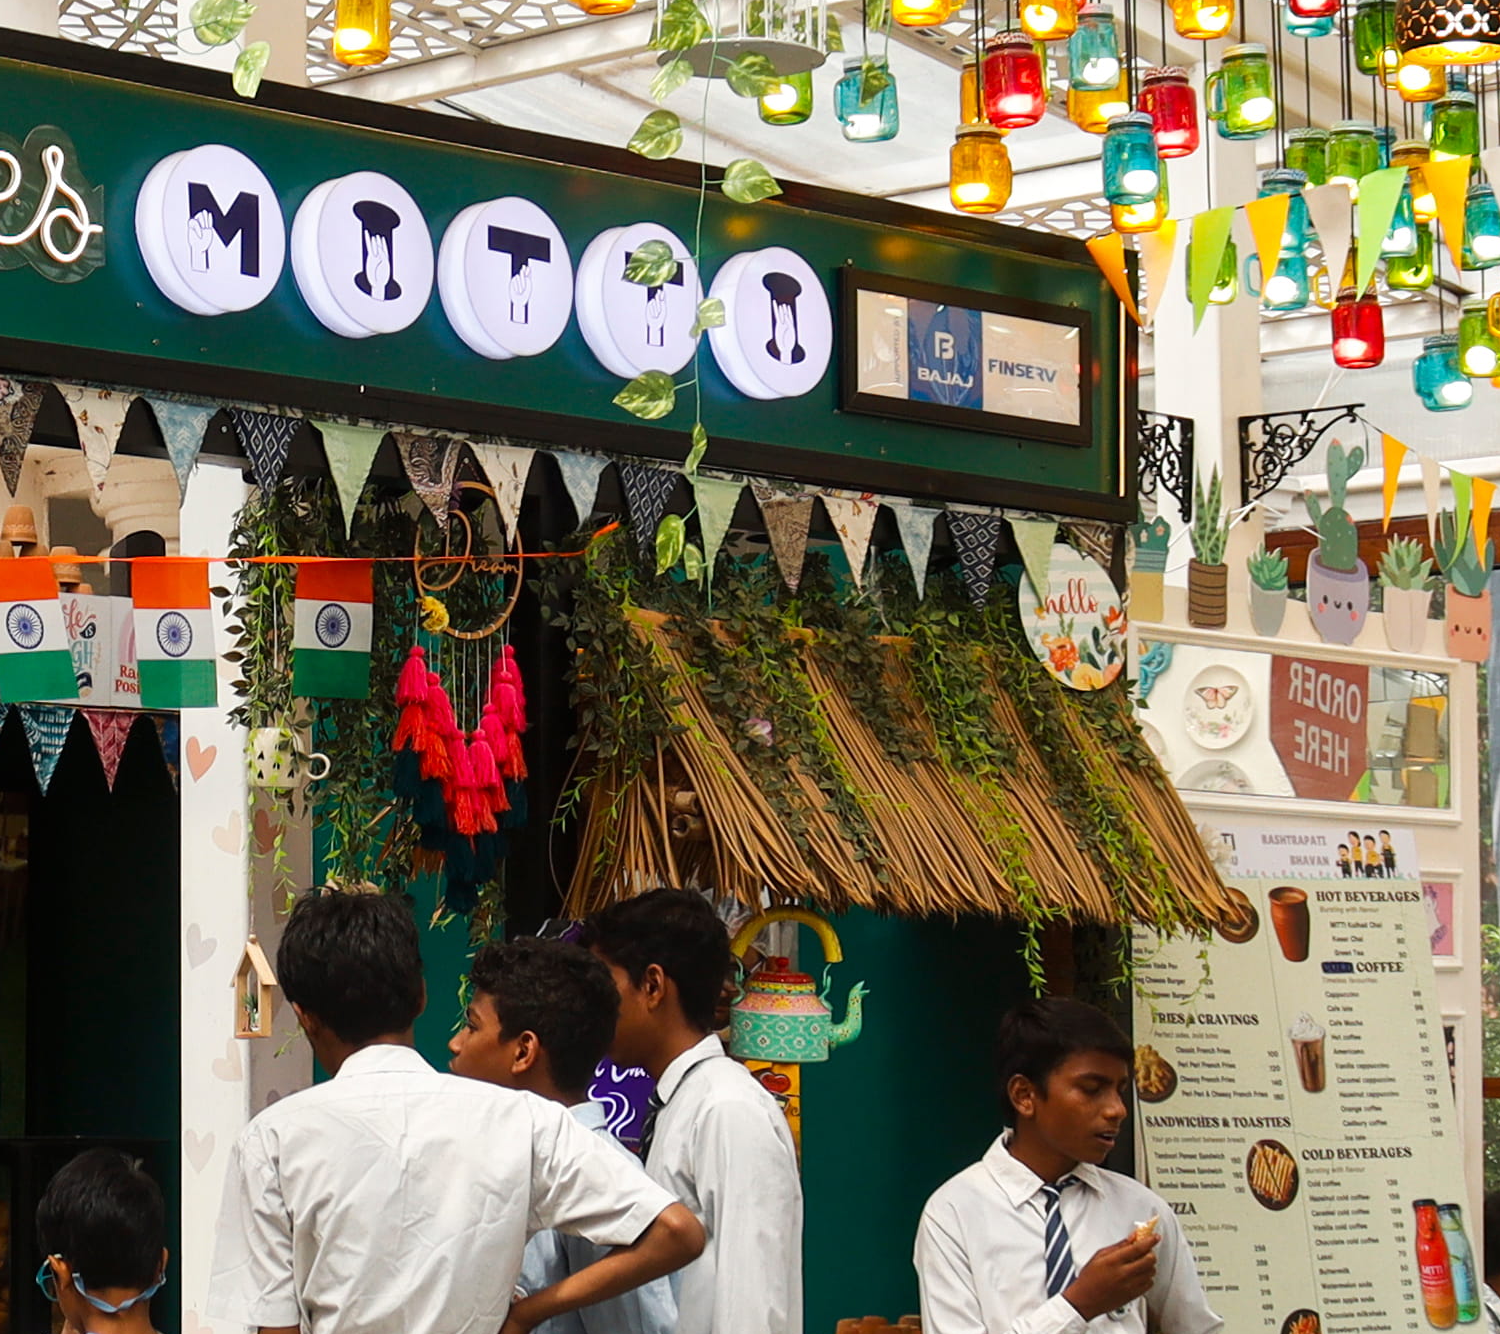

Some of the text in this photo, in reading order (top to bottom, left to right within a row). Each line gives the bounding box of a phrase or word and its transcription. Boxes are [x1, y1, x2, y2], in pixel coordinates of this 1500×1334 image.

[917, 367, 974, 388] BAJAJ
[988, 358, 1058, 383] FINSERV
[1044, 577, 1099, 615] hello
[1316, 891, 1421, 903] HOT BEVERAGES
[1356, 961, 1405, 973] COFFEE
[1198, 1013, 1260, 1025] CRAVINGS
[1145, 1115, 1220, 1128] SANDWICHES
[1232, 1116, 1292, 1128] TOASTIES
[1301, 1146, 1413, 1161] COLD BEVERAGES
